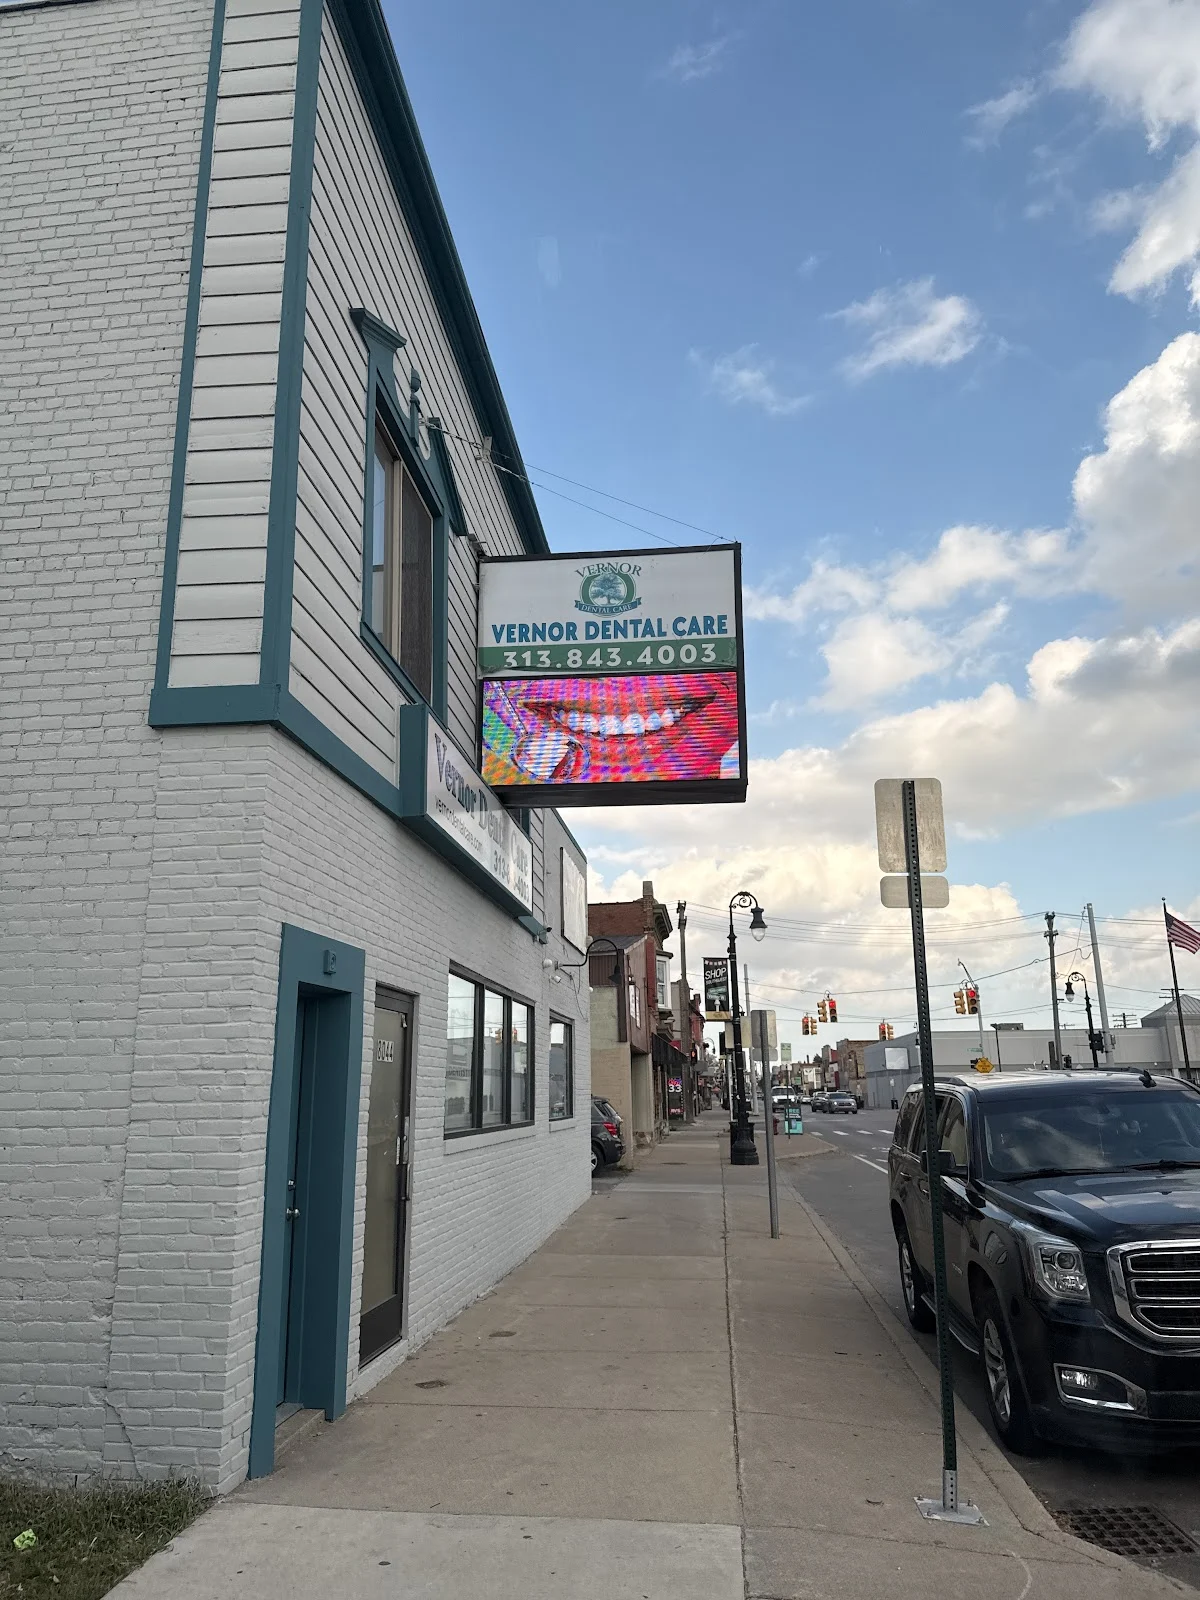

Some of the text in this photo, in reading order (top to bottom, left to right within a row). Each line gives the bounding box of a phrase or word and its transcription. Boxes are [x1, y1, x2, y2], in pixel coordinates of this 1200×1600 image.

[574, 562, 642, 577] VERNOR
[581, 604, 632, 613] DENTAL CARE
[492, 614, 728, 644] VERNOR DENTAL CARE
[503, 643, 717, 669] 313.843.4003
[434, 732, 477, 820] Vernor
[511, 829, 529, 877] Care
[704, 967, 727, 980] SHOP
